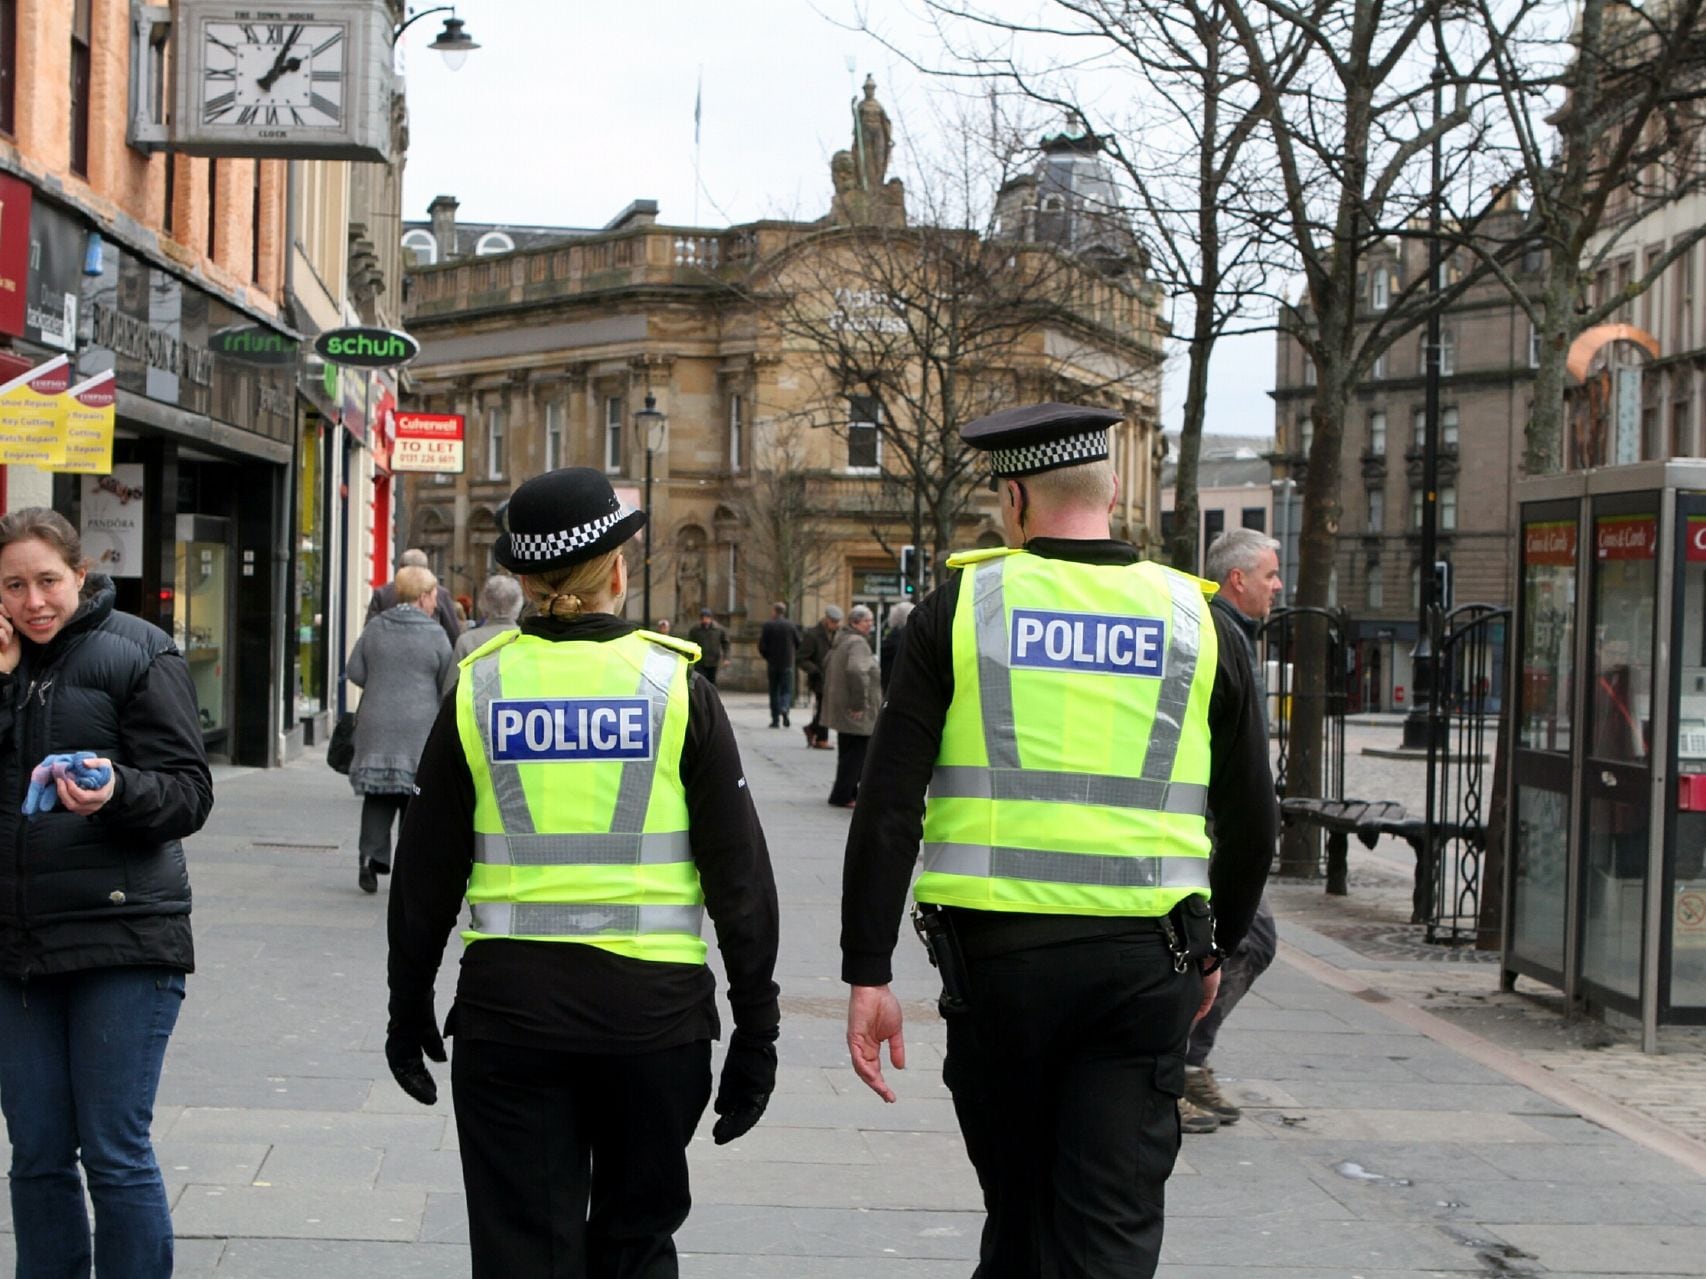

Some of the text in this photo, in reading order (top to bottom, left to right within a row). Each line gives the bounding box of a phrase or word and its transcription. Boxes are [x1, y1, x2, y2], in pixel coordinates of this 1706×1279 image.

[327, 334, 406, 357] schuh
[24, 400, 58, 408] Repairs
[2, 418, 55, 428] Key Cutting
[400, 417, 457, 431] Culverwell
[26, 435, 58, 444] Repairs
[69, 429, 102, 439] Cutting
[400, 441, 454, 453] TO LET
[4, 451, 49, 460] Engraving
[1599, 526, 1618, 548] Coins
[1625, 524, 1647, 548] Cards
[1016, 617, 1158, 668] POLICE
[497, 706, 644, 752] POLICE
